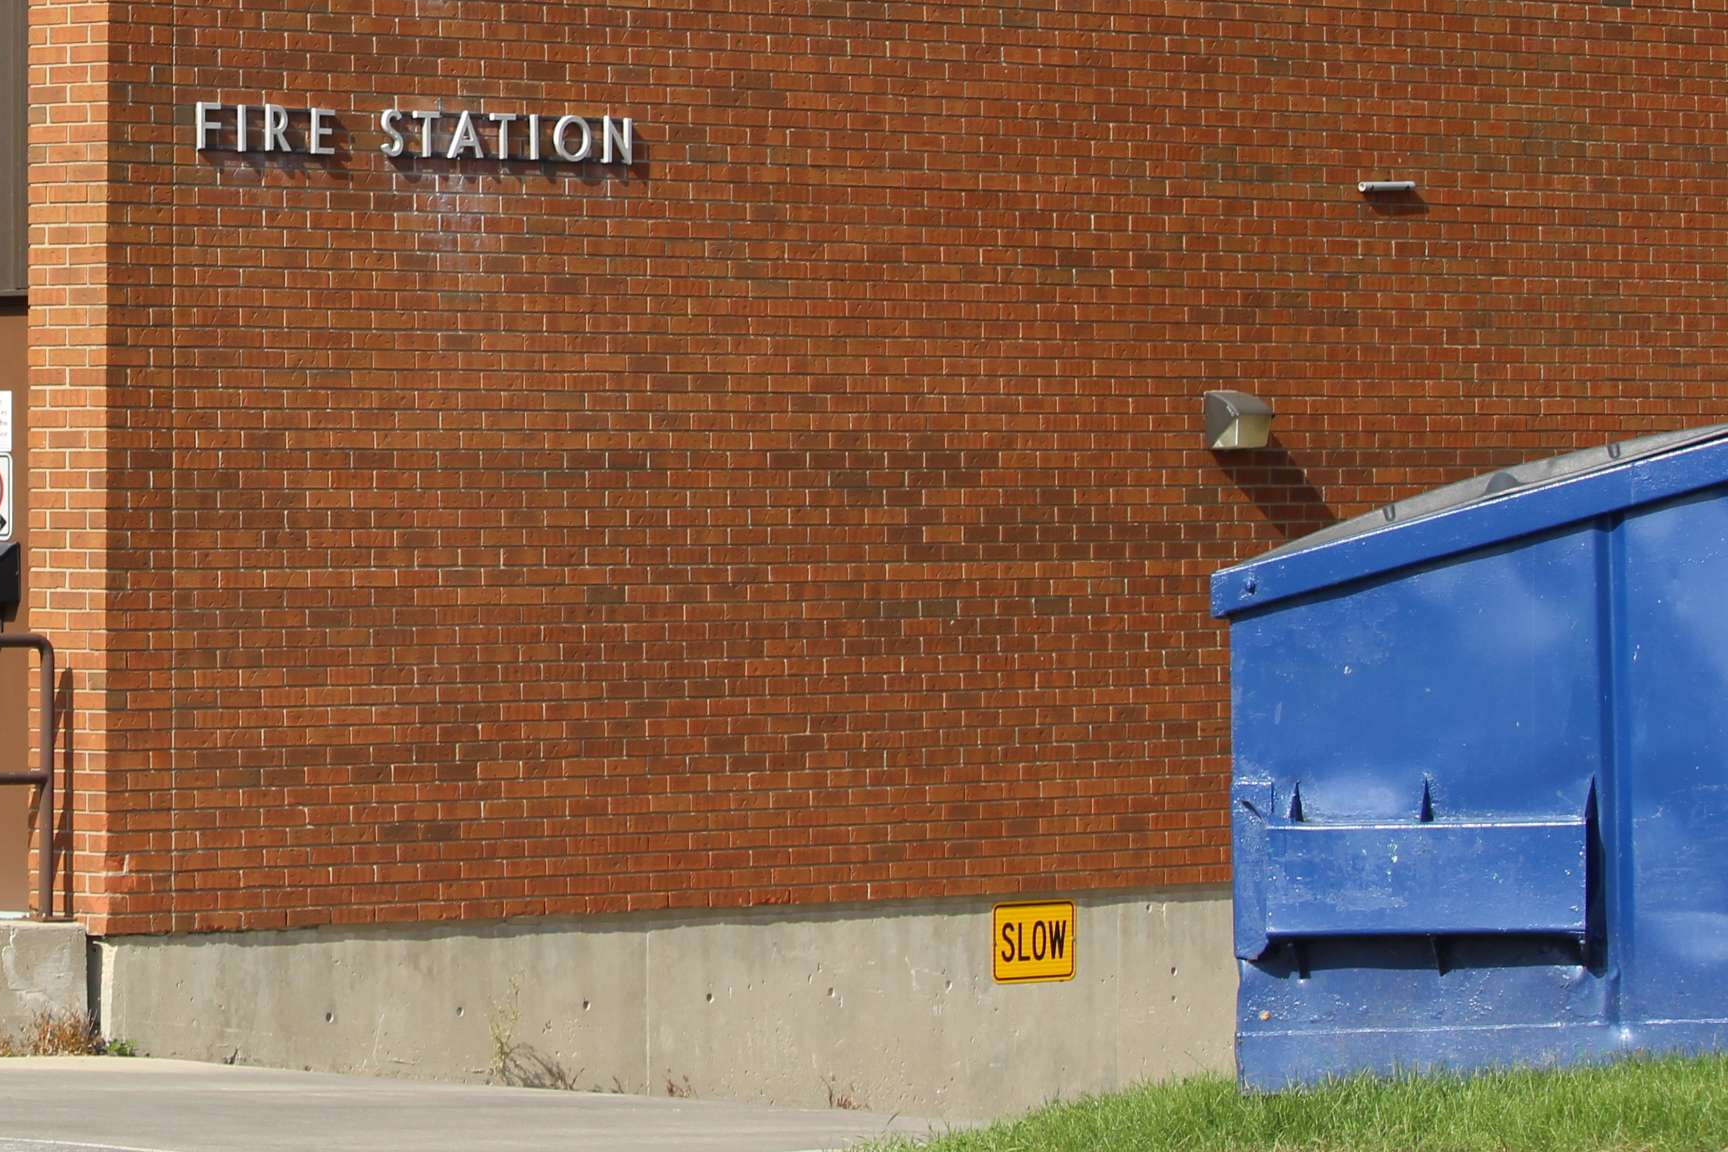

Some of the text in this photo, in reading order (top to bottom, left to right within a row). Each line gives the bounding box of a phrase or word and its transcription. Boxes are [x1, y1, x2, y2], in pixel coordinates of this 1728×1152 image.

[195, 101, 633, 165] FIRE STATION
[1001, 920, 1067, 962] SLOW
